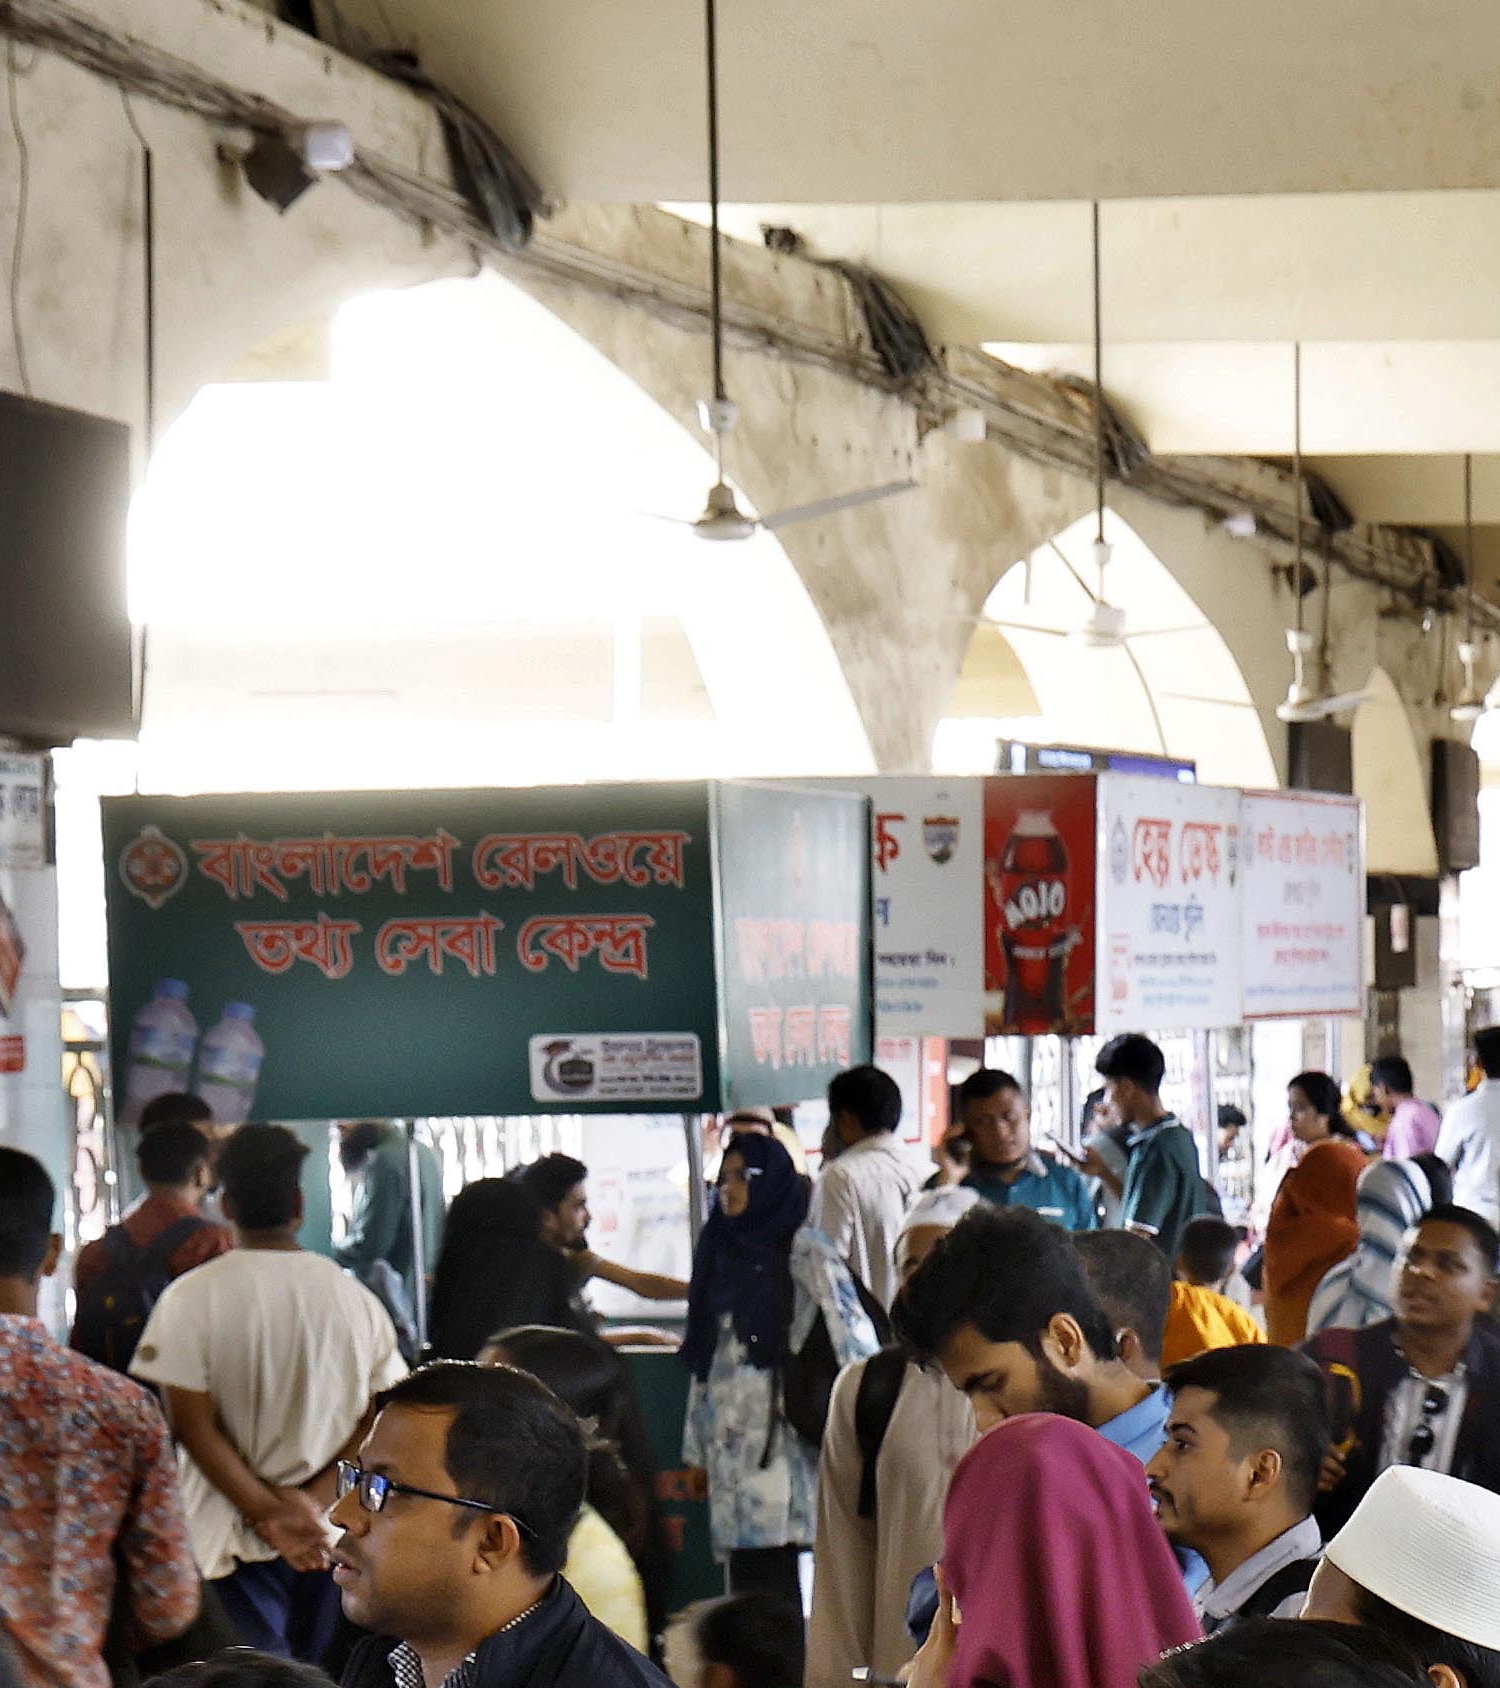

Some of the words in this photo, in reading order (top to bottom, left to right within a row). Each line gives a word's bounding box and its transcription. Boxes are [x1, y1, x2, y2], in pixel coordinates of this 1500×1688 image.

[191, 828, 461, 901] বাংলাদেশ
[472, 828, 692, 892] রেলওয়ে
[234, 911, 362, 981] তথ্য
[375, 910, 505, 979] সেবা
[517, 911, 655, 981] কেন্দ্র
